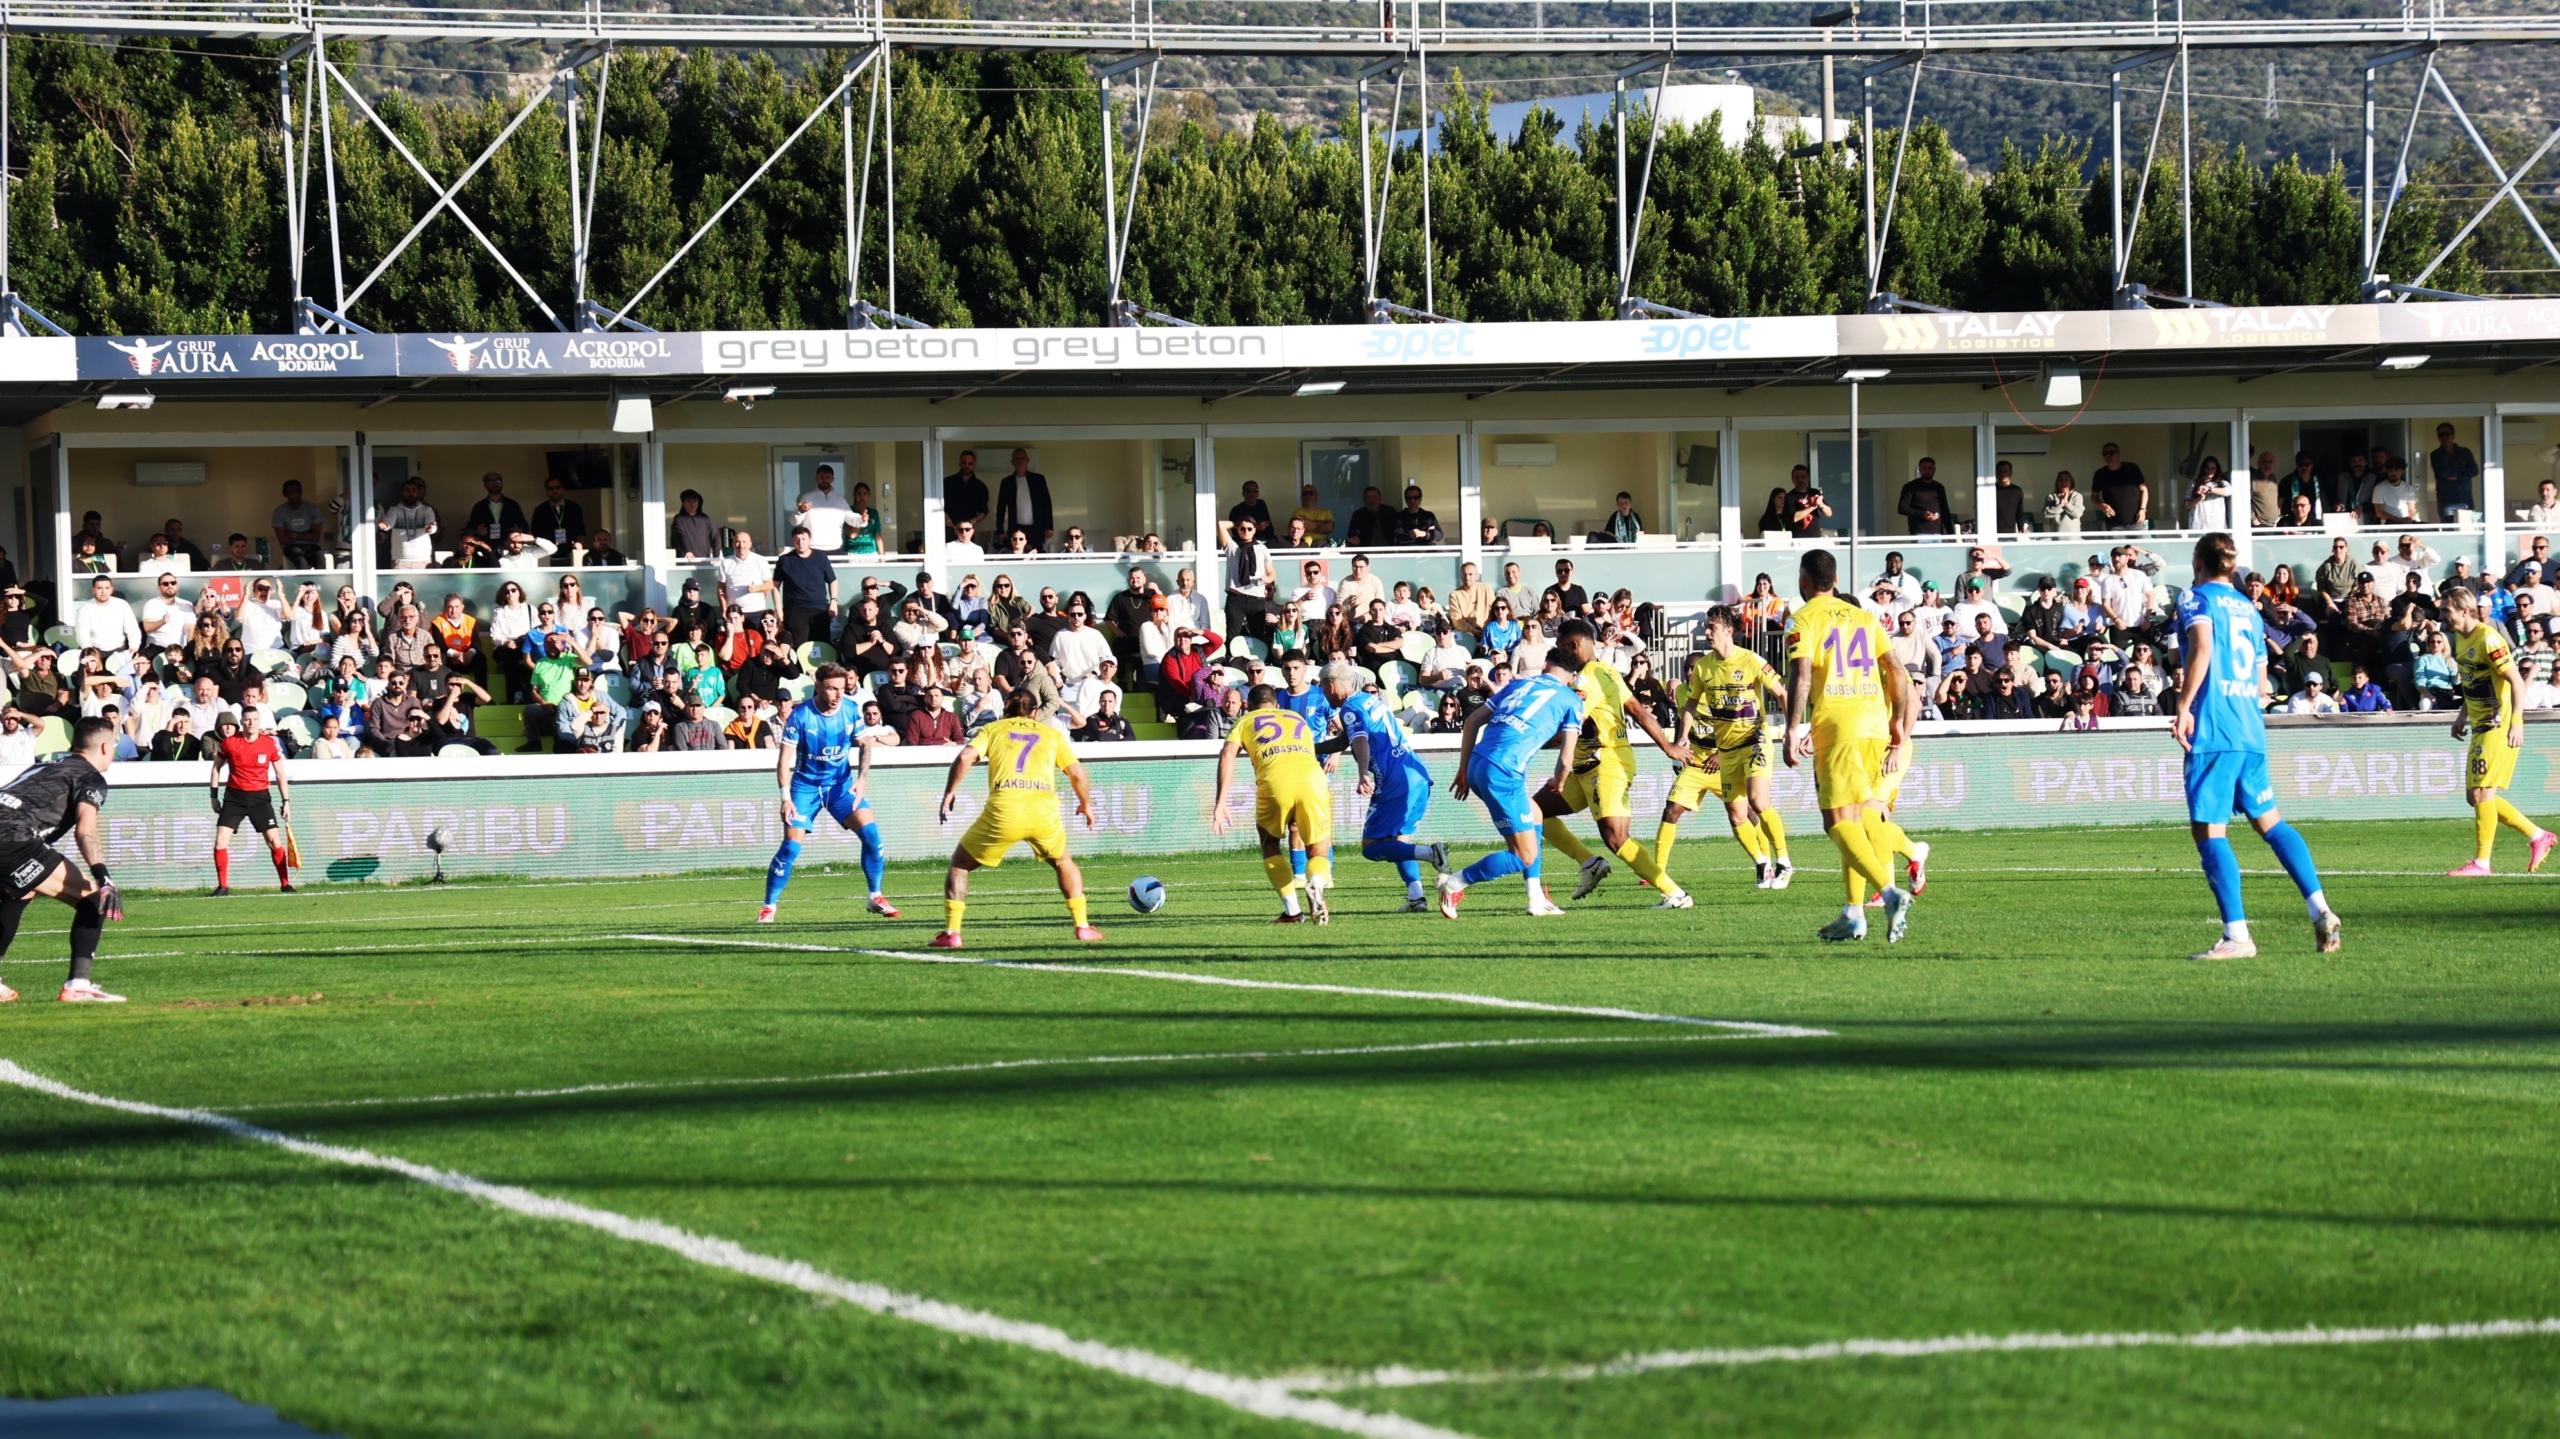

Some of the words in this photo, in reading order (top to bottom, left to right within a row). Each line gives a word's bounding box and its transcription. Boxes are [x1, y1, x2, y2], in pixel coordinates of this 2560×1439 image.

[1939, 313, 2065, 337] TALAY
[2211, 307, 2336, 332] TALAY
[2447, 315, 2513, 336] AURA
[177, 341, 216, 352] GRUP
[493, 338, 530, 350] GRUP
[563, 338, 671, 358] ACROPOL
[1013, 336, 1120, 365] grey
[1136, 329, 1266, 356] beton
[1363, 325, 1475, 362] opet
[1642, 319, 1753, 358] opet
[1946, 337, 2056, 350] LOGISTICS
[2219, 331, 2325, 345] LOGISTICS
[250, 341, 364, 361] ACROPOL
[477, 349, 552, 369] AURA
[718, 339, 828, 369] grey
[845, 332, 979, 359] beton
[160, 351, 239, 373] AURA
[278, 360, 337, 372] BODRUM
[589, 358, 646, 369] BODRUM
[1824, 627, 1874, 677] 14
[2230, 616, 2256, 681] 5
[1826, 684, 1856, 696] RUBEN
[1254, 714, 1306, 744] 57
[1008, 732, 1040, 773] 7
[2295, 749, 2467, 798] PARiB
[2471, 758, 2487, 775] 88
